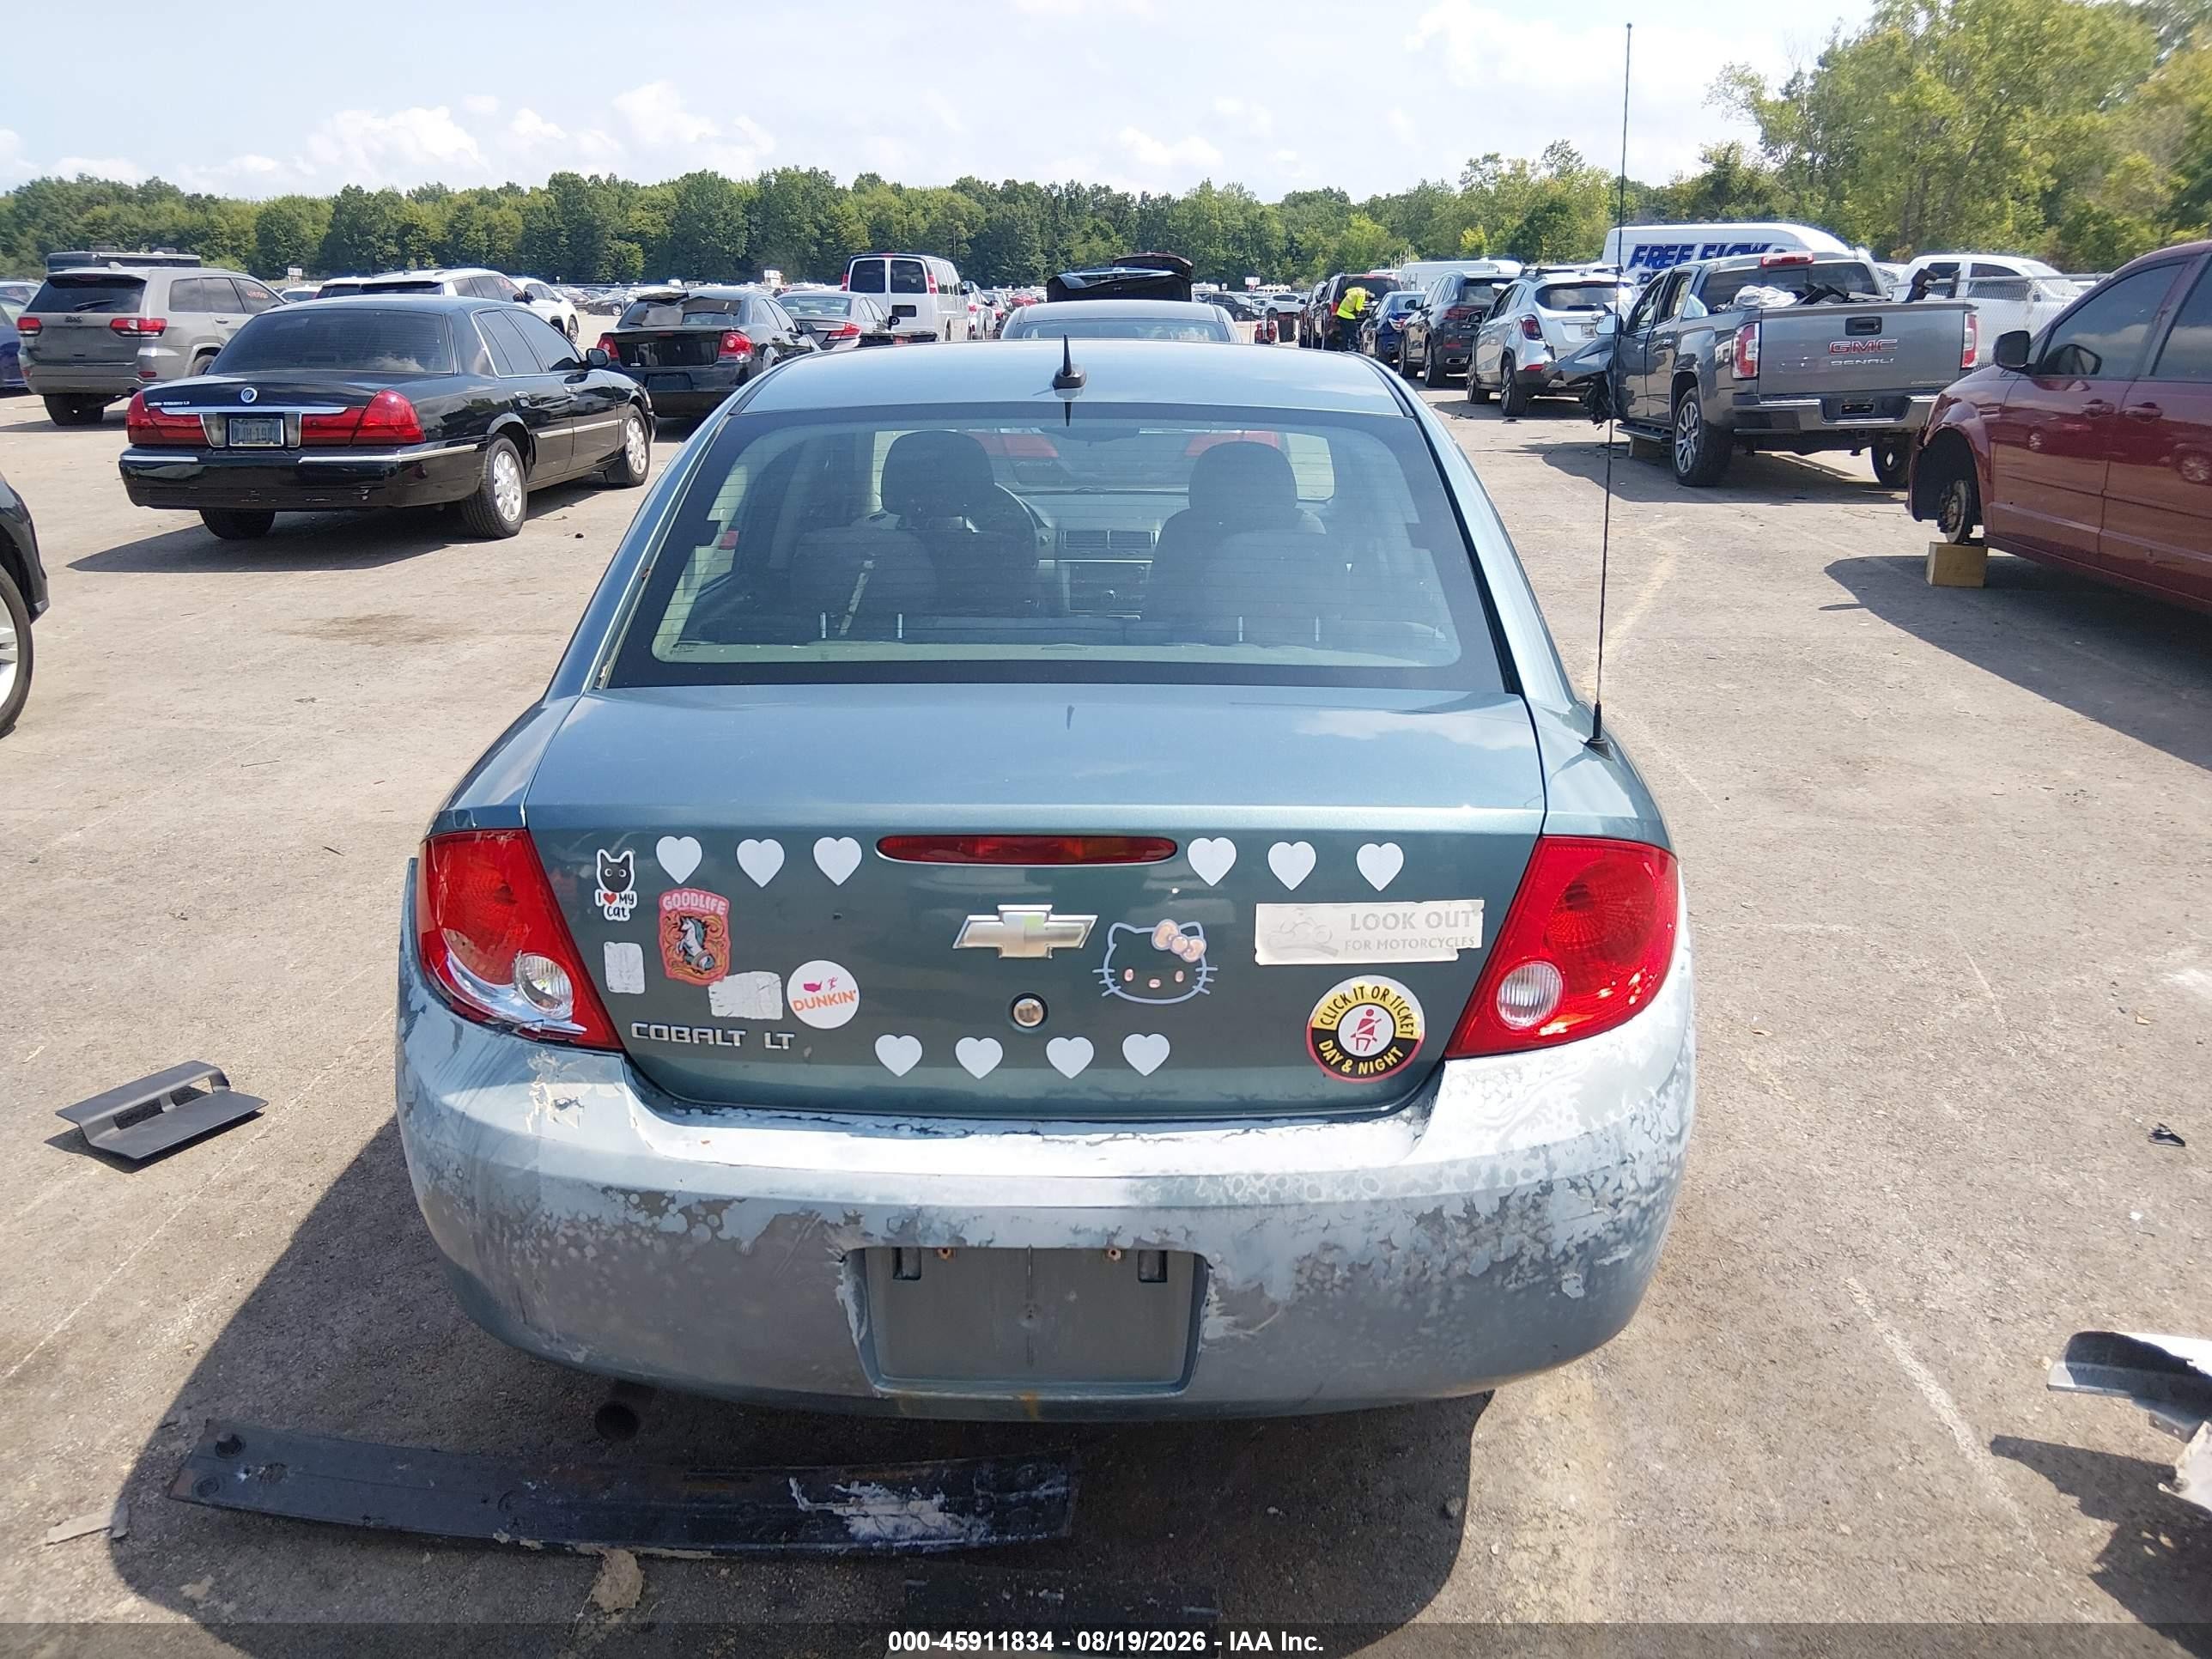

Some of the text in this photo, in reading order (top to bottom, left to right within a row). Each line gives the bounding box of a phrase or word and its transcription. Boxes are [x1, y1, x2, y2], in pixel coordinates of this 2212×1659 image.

[1626, 244, 1698, 270] FREE
[1829, 338, 1898, 355] GMC
[607, 906, 627, 918] cat
[663, 892, 727, 915] GOODLIFE
[1350, 910, 1474, 931] LOOK OUT
[1344, 936, 1475, 951] FOR MOTORCYCLES
[793, 989, 857, 1012] DUNKIN'
[1320, 986, 1414, 1036] CLICK IT OR TICKET
[630, 1022, 795, 1050] COBALT LT
[1318, 1039, 1404, 1075] DAY & NIGHT
